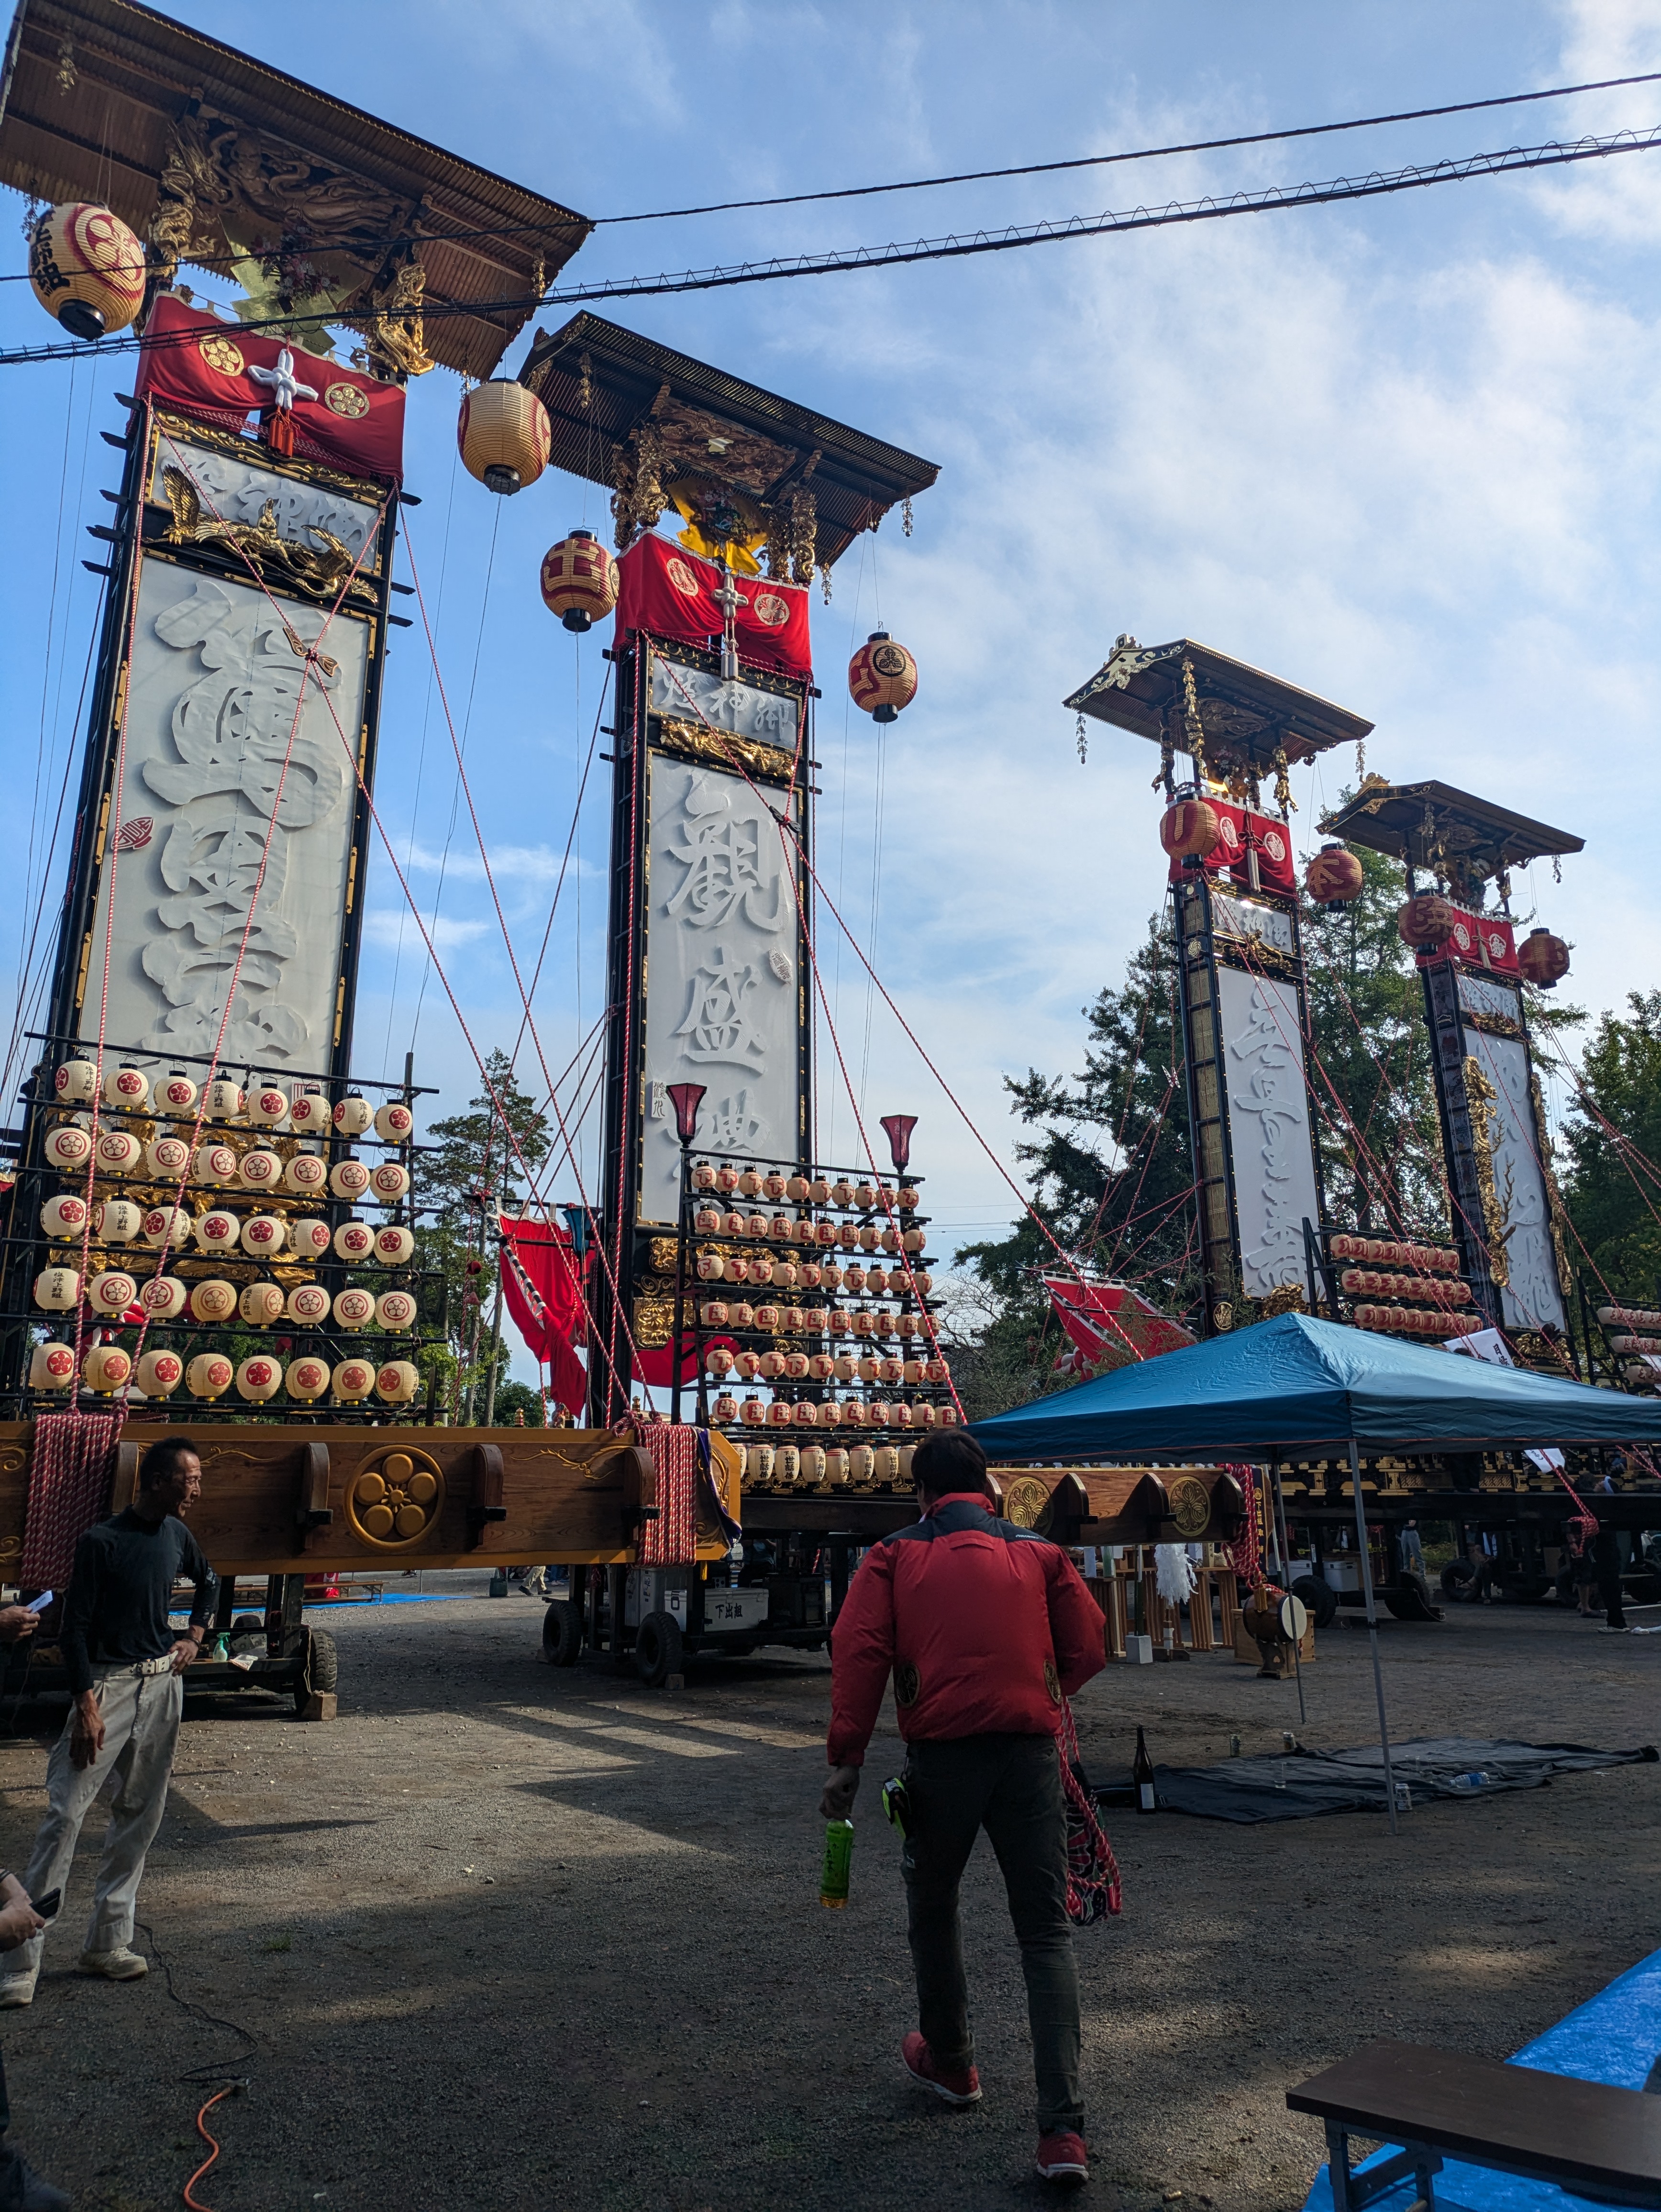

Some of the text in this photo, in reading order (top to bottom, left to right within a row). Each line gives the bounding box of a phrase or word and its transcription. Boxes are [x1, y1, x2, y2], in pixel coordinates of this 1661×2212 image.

[544, 539, 601, 593] 出
[214, 1084, 224, 1107] 塩津上野組
[696, 1170, 711, 1184] 下
[721, 1171, 737, 1185] 下
[751, 1176, 762, 1190] 下
[769, 1179, 784, 1193] 下
[841, 1186, 853, 1199] 下
[117, 1205, 128, 1230] 塩津上野組
[700, 1213, 715, 1227] 出
[732, 1216, 743, 1231] 出
[752, 1220, 766, 1233] 出
[776, 1221, 790, 1235] 出
[823, 1227, 835, 1239] 出
[845, 1228, 857, 1242] 出
[698, 1259, 710, 1275] 下
[735, 1262, 747, 1275] 下
[755, 1263, 769, 1277] 下
[805, 1267, 819, 1283] 下
[828, 1269, 841, 1282] 下
[849, 1271, 864, 1285] 下
[900, 1273, 910, 1286] 下
[52, 1272, 64, 1298] 塩津上野組
[712, 1306, 726, 1320] 出
[742, 1307, 753, 1322] 出
[762, 1310, 775, 1323] 出
[791, 1311, 802, 1326] 出
[810, 1312, 825, 1327] 出
[835, 1313, 848, 1328] 出
[862, 1316, 873, 1328] 出
[883, 1316, 895, 1331] 出
[907, 1318, 918, 1331] 出
[717, 1353, 731, 1368] 下
[748, 1356, 759, 1370] 下
[772, 1355, 785, 1370] 下
[787, 1358, 803, 1373] 下
[819, 1360, 831, 1375] 下
[844, 1360, 857, 1375] 下
[889, 1362, 902, 1376] 下
[929, 1364, 943, 1378] 下
[720, 1400, 735, 1416] 出
[752, 1405, 764, 1418] 出
[777, 1406, 790, 1420] 出
[799, 1405, 814, 1421] 出
[827, 1406, 840, 1421] 出
[851, 1405, 864, 1420] 出
[874, 1406, 887, 1422] 出
[902, 1407, 911, 1423] 出
[946, 1411, 956, 1423] 出
[759, 1456, 769, 1478] 世話係
[785, 1456, 795, 1479] 世話係
[889, 1457, 897, 1478] 世話係
[1255, 1501, 1263, 1526] 下出組
[715, 1603, 743, 1619] 下出組
